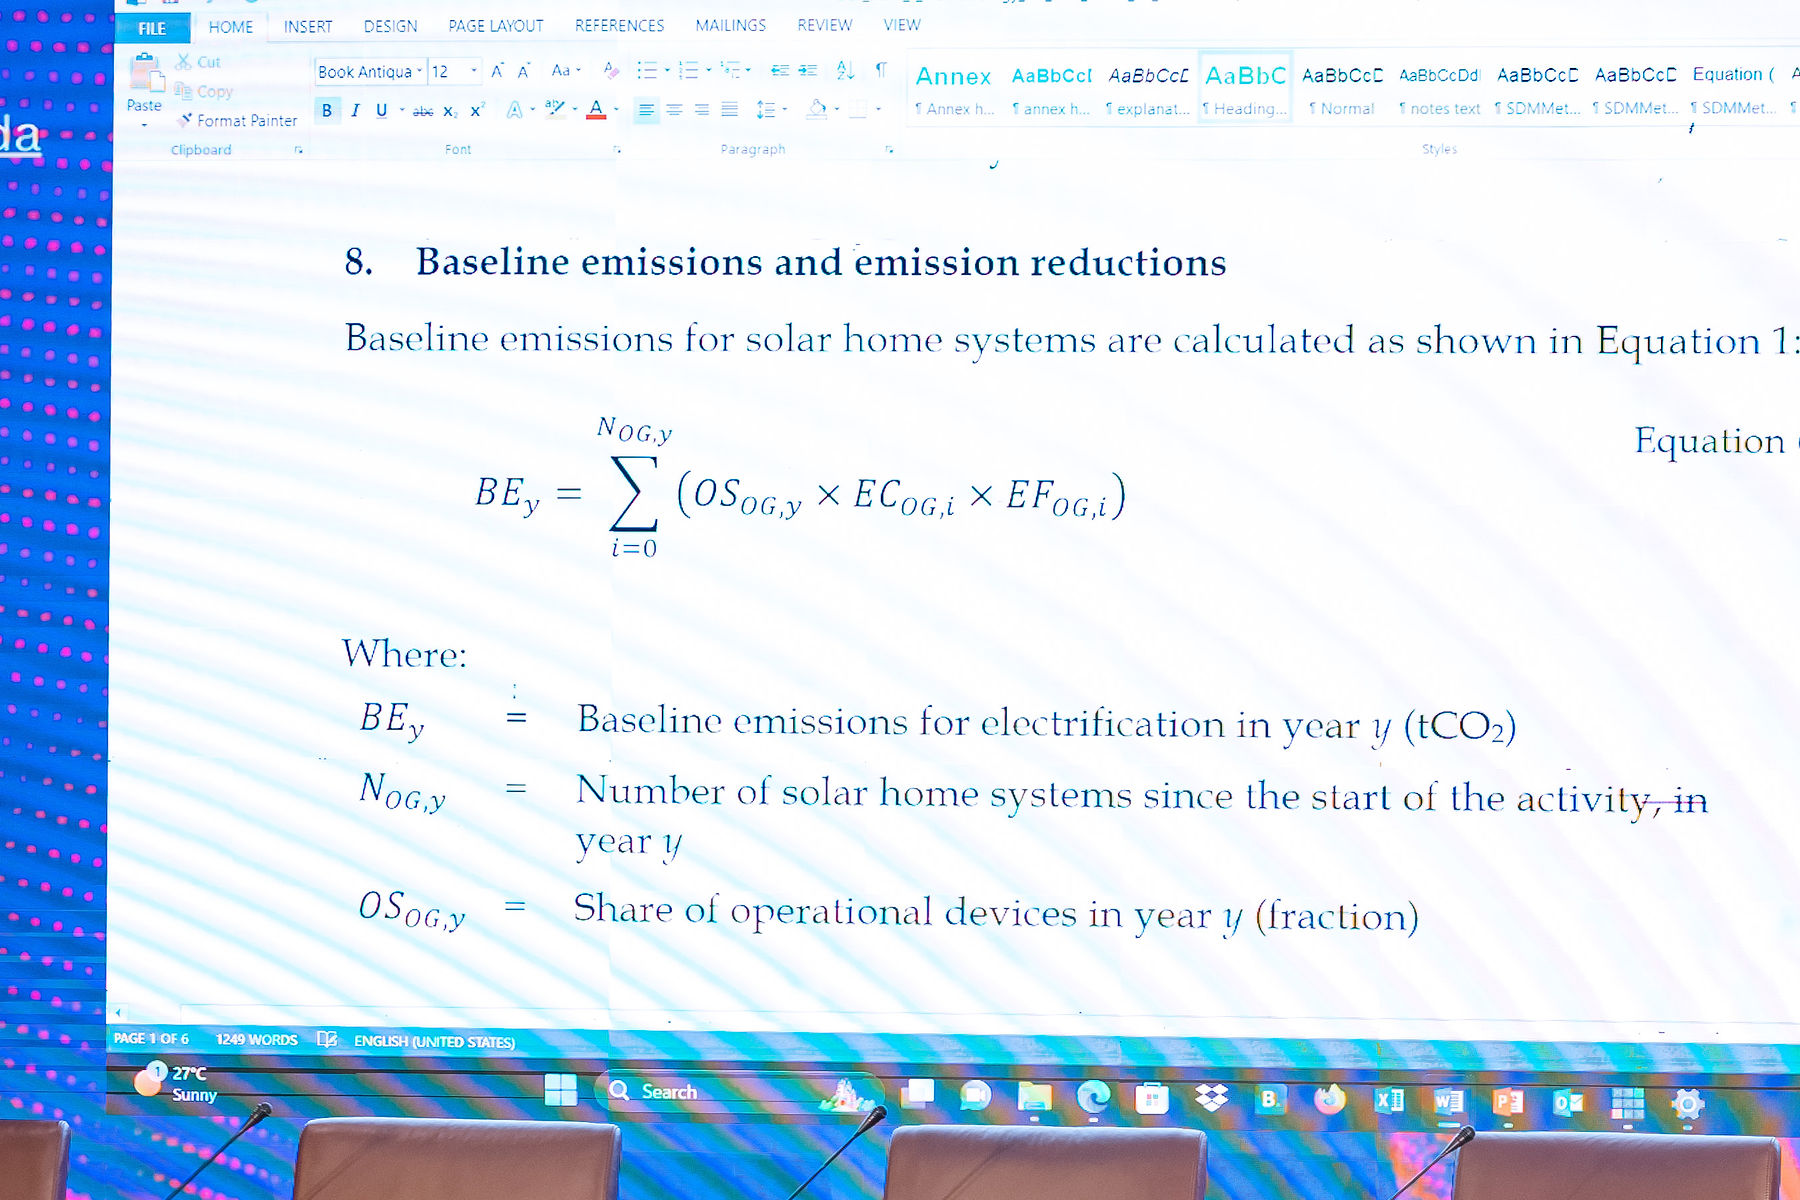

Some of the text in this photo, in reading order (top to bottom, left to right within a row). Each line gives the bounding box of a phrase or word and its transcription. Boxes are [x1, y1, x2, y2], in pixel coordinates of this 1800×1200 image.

[139, 18, 921, 36] FILE HOME INSERT DESIGN PAGE LAYOUT REFERENCES MAILINGS REVIEW VIEW
[198, 56, 220, 69] Cut
[319, 65, 413, 81] Book Antiqua
[433, 65, 448, 78] 12
[198, 85, 233, 101] Copy
[127, 99, 162, 113] Paste
[198, 114, 298, 128] Format Painter
[171, 144, 232, 157] Clipboard
[446, 143, 472, 155] Font
[721, 143, 786, 158] Paragraph
[1423, 143, 1458, 156] Styles
[345, 245, 1226, 277] 8. Baseline emissions and emission reductions
[345, 321, 1800, 365] Baseline emissions for solar home systems are calculated as shown in Equation 1:
[1635, 426, 1785, 463] Equation
[341, 637, 466, 668] Where:
[577, 703, 722, 734] Baseline
[734, 708, 908, 735] emissions
[920, 704, 970, 736] for
[981, 705, 1225, 738] electrification
[1237, 711, 1272, 738] in
[1282, 718, 1360, 750] year
[1371, 719, 1392, 751] y
[577, 774, 1708, 824] Number of solar home systems since the start of the activity, in
[575, 833, 683, 866] year y
[574, 891, 1418, 940] Share of operational devices in year y (fraction)
[114, 1033, 147, 1046] PAGE
[160, 1033, 177, 1045] OF
[181, 1033, 189, 1046] 6
[216, 1034, 246, 1046] 1249
[248, 1034, 299, 1047] WORDS
[354, 1035, 409, 1048] ENGLISH
[412, 1036, 466, 1050] (UNITED
[468, 1036, 516, 1051] STATES)
[172, 1066, 207, 1081] 27°C
[172, 1088, 218, 1104] Sunny
[642, 1083, 698, 1100] Search
